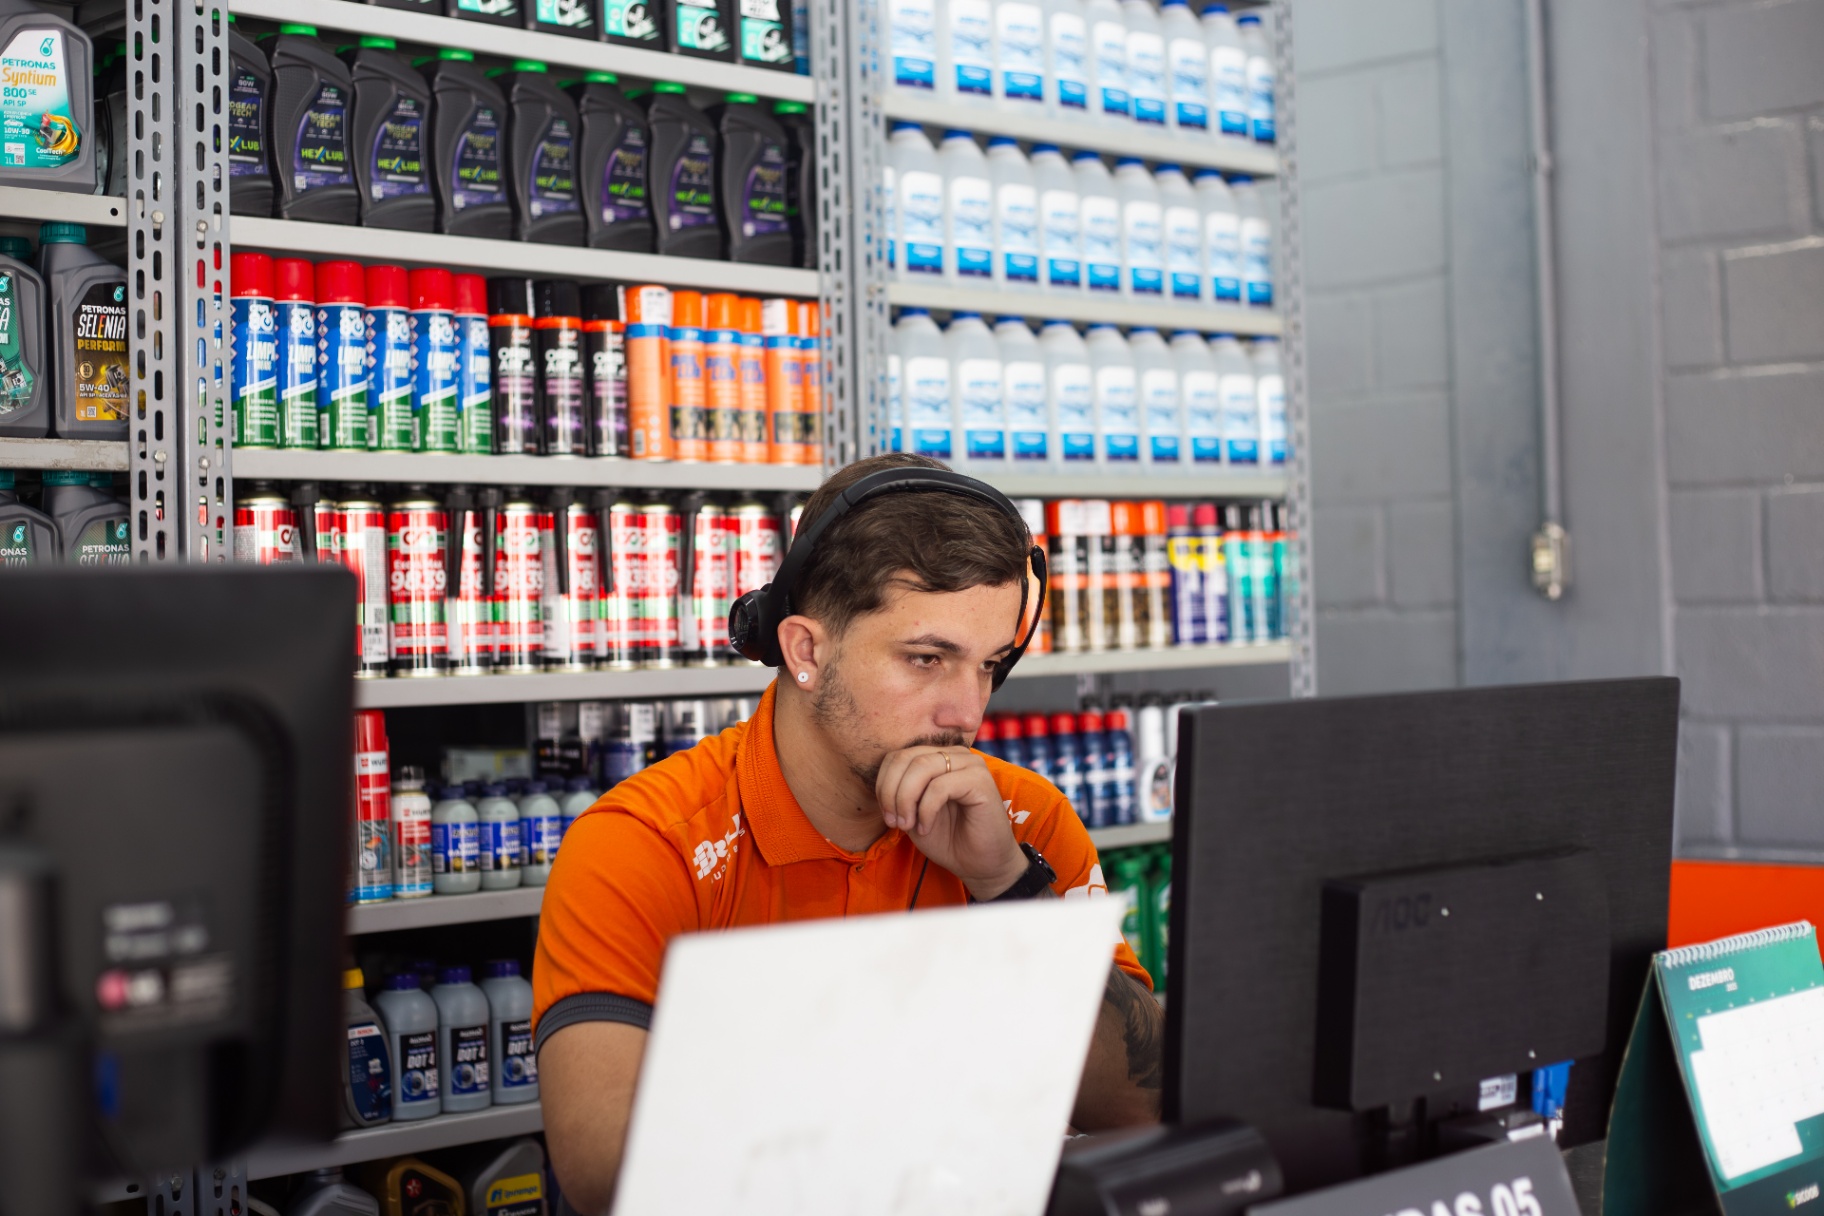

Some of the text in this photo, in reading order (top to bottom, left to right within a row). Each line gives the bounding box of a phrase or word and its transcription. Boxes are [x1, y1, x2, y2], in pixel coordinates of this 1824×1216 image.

[2, 58, 56, 70] PETRONAS
[2, 67, 57, 87] Syntium
[3, 87, 27, 98] 800
[81, 304, 126, 315] PETRONAS
[77, 314, 126, 339] SELENIA
[77, 338, 126, 352] PERFORM
[79, 383, 109, 392] 5W-40
[0, 548, 27, 556] ONAS
[82, 544, 129, 553] PETRONAS
[1688, 967, 1734, 990] DEZEMBRO
[457, 1045, 486, 1062] DOT 4
[508, 1040, 528, 1055] DOT
[407, 1052, 435, 1069] DOT 4
[1490, 1176, 1542, 1216] 05
